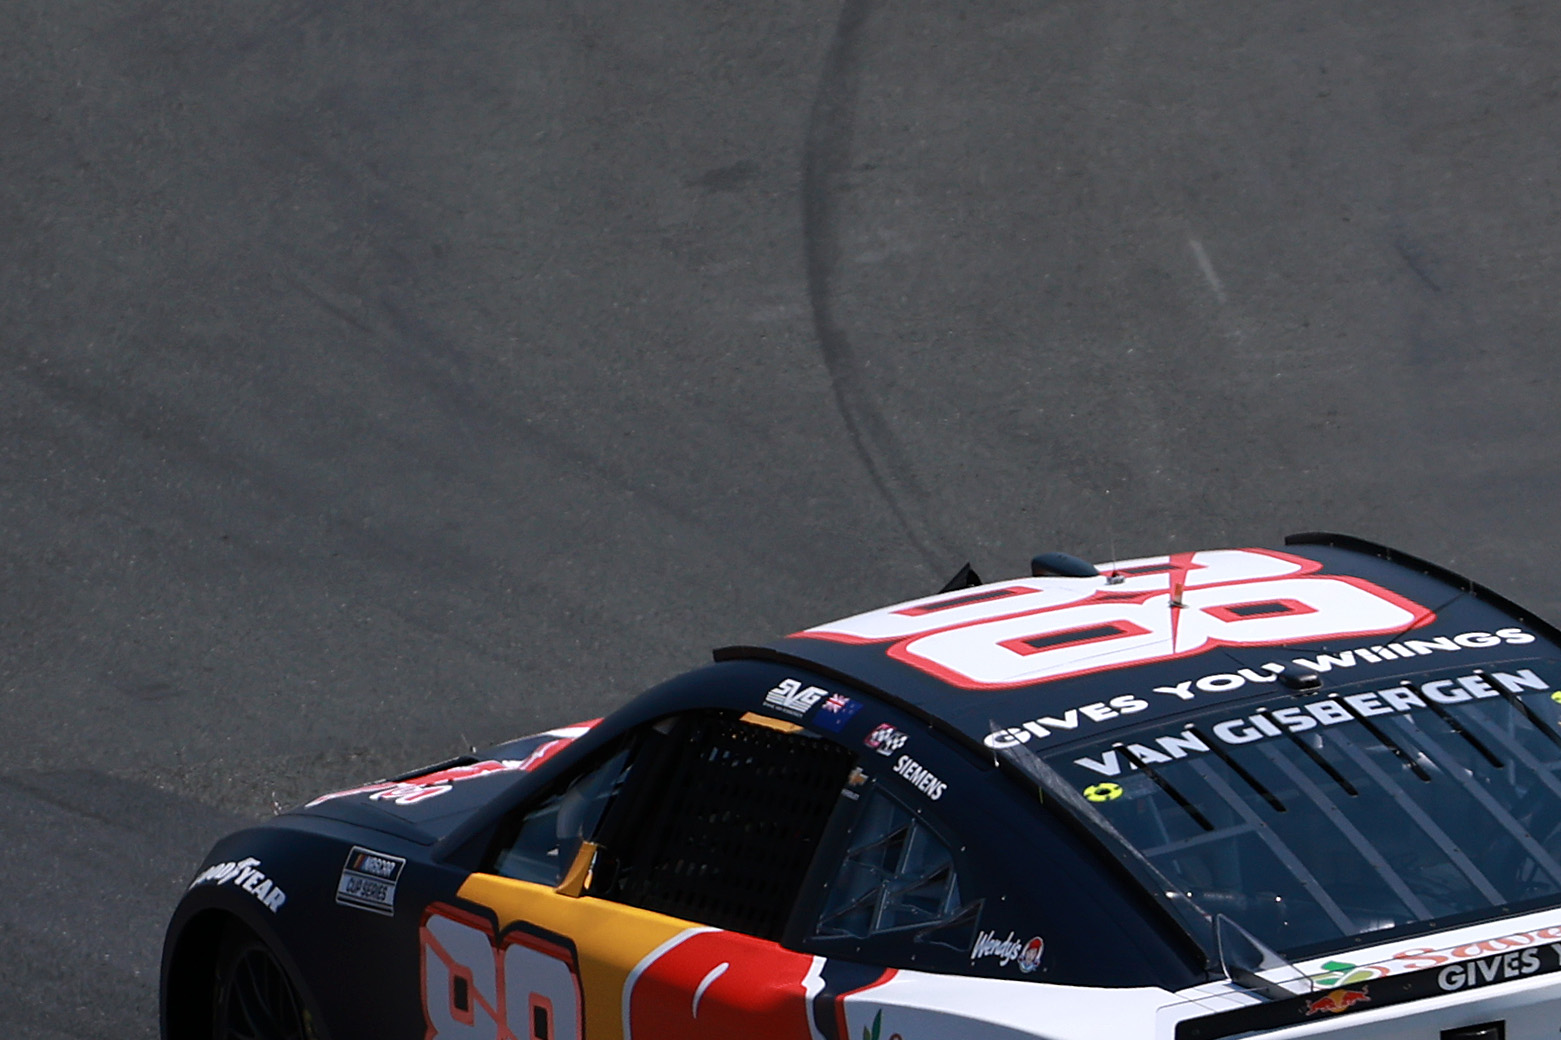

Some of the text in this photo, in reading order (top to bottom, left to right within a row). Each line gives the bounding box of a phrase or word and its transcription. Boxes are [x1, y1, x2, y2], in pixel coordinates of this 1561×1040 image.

[785, 547, 1437, 690] 88
[766, 678, 829, 714] SVG
[984, 628, 1536, 748] GIVES YOU WIIINGS
[1074, 669, 1550, 777] VAN GISBERGEN
[893, 755, 948, 800] SIEMENS
[188, 857, 287, 914] OODYEAR
[970, 930, 1022, 967] Wendy's
[1437, 948, 1540, 992] GIVES
